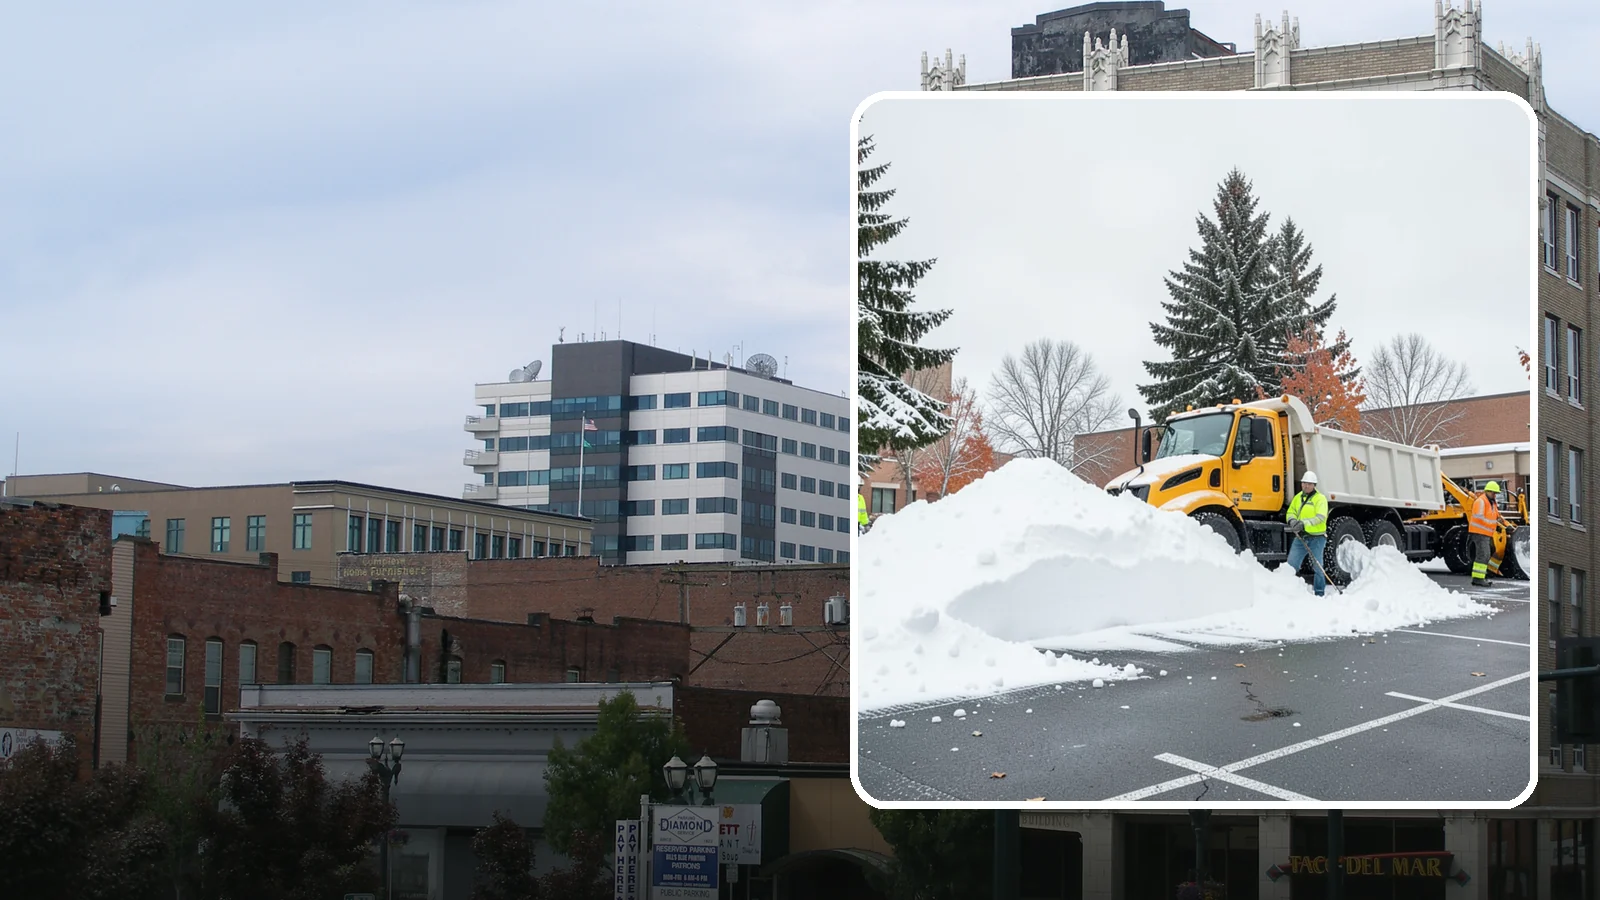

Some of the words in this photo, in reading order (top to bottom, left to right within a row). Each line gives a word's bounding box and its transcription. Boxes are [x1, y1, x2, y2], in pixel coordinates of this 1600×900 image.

[343, 568, 368, 577] Home
[370, 566, 427, 577] Furnishers
[660, 818, 713, 832] DIAMOND
[1021, 815, 1069, 828] BUILDING
[617, 825, 625, 852] PAY
[628, 825, 637, 852] PAY
[689, 846, 716, 854] PARKING
[721, 852, 739, 861] Soup
[671, 862, 701, 870] PATRONS
[1345, 856, 1385, 875] DEL
[1392, 858, 1442, 876] MAR
[617, 856, 625, 893] HERE
[628, 856, 636, 893] HERE
[660, 888, 681, 897] PUBLIC
[683, 890, 710, 898] PARKING
